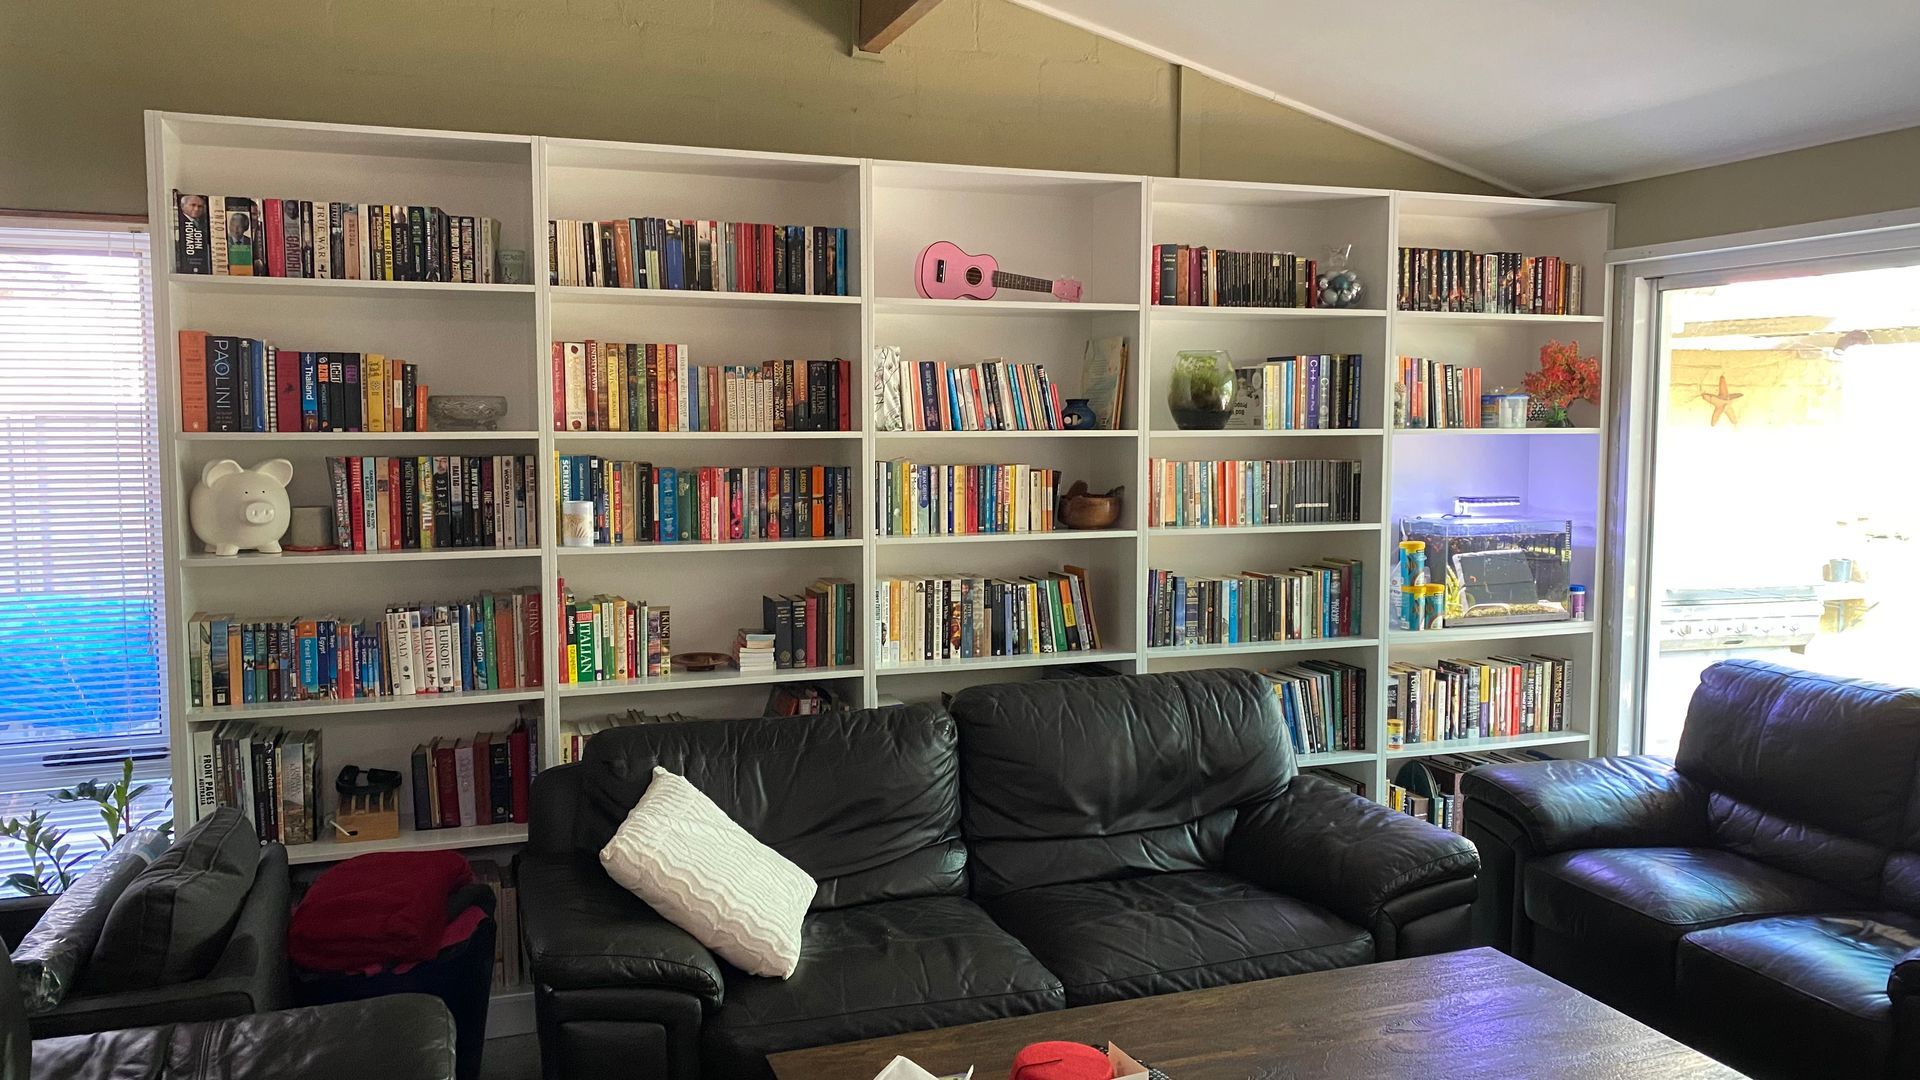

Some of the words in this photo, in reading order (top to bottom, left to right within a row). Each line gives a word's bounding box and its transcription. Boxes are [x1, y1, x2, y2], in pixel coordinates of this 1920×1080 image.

[214, 209, 224, 232] ENZO
[317, 206, 325, 232] TRUE
[185, 222, 194, 255] HOWARD
[194, 228, 202, 249] JOHN
[318, 236, 326, 258] WAR
[214, 236, 226, 274] FERRARI
[286, 236, 301, 272] GANDHI
[452, 248, 460, 261] TWO
[214, 340, 231, 408] PAOLINI
[305, 366, 314, 400] Thailand
[1310, 360, 1318, 381] C++
[1321, 378, 1329, 397] C++
[484, 491, 493, 504] ONE
[422, 501, 432, 529] WILL
[529, 601, 538, 636] CHINA
[304, 639, 312, 658] Great
[398, 631, 408, 659] ITALY
[413, 631, 421, 655] JAPAN
[424, 629, 435, 666] CHINA
[439, 629, 450, 669] EUROPE
[475, 632, 484, 663] London
[580, 623, 592, 673] ITALIAN
[1410, 675, 1419, 703] POWELL
[203, 754, 212, 778] FRONT
[266, 758, 274, 789] speeches
[205, 782, 214, 805] PAGES
